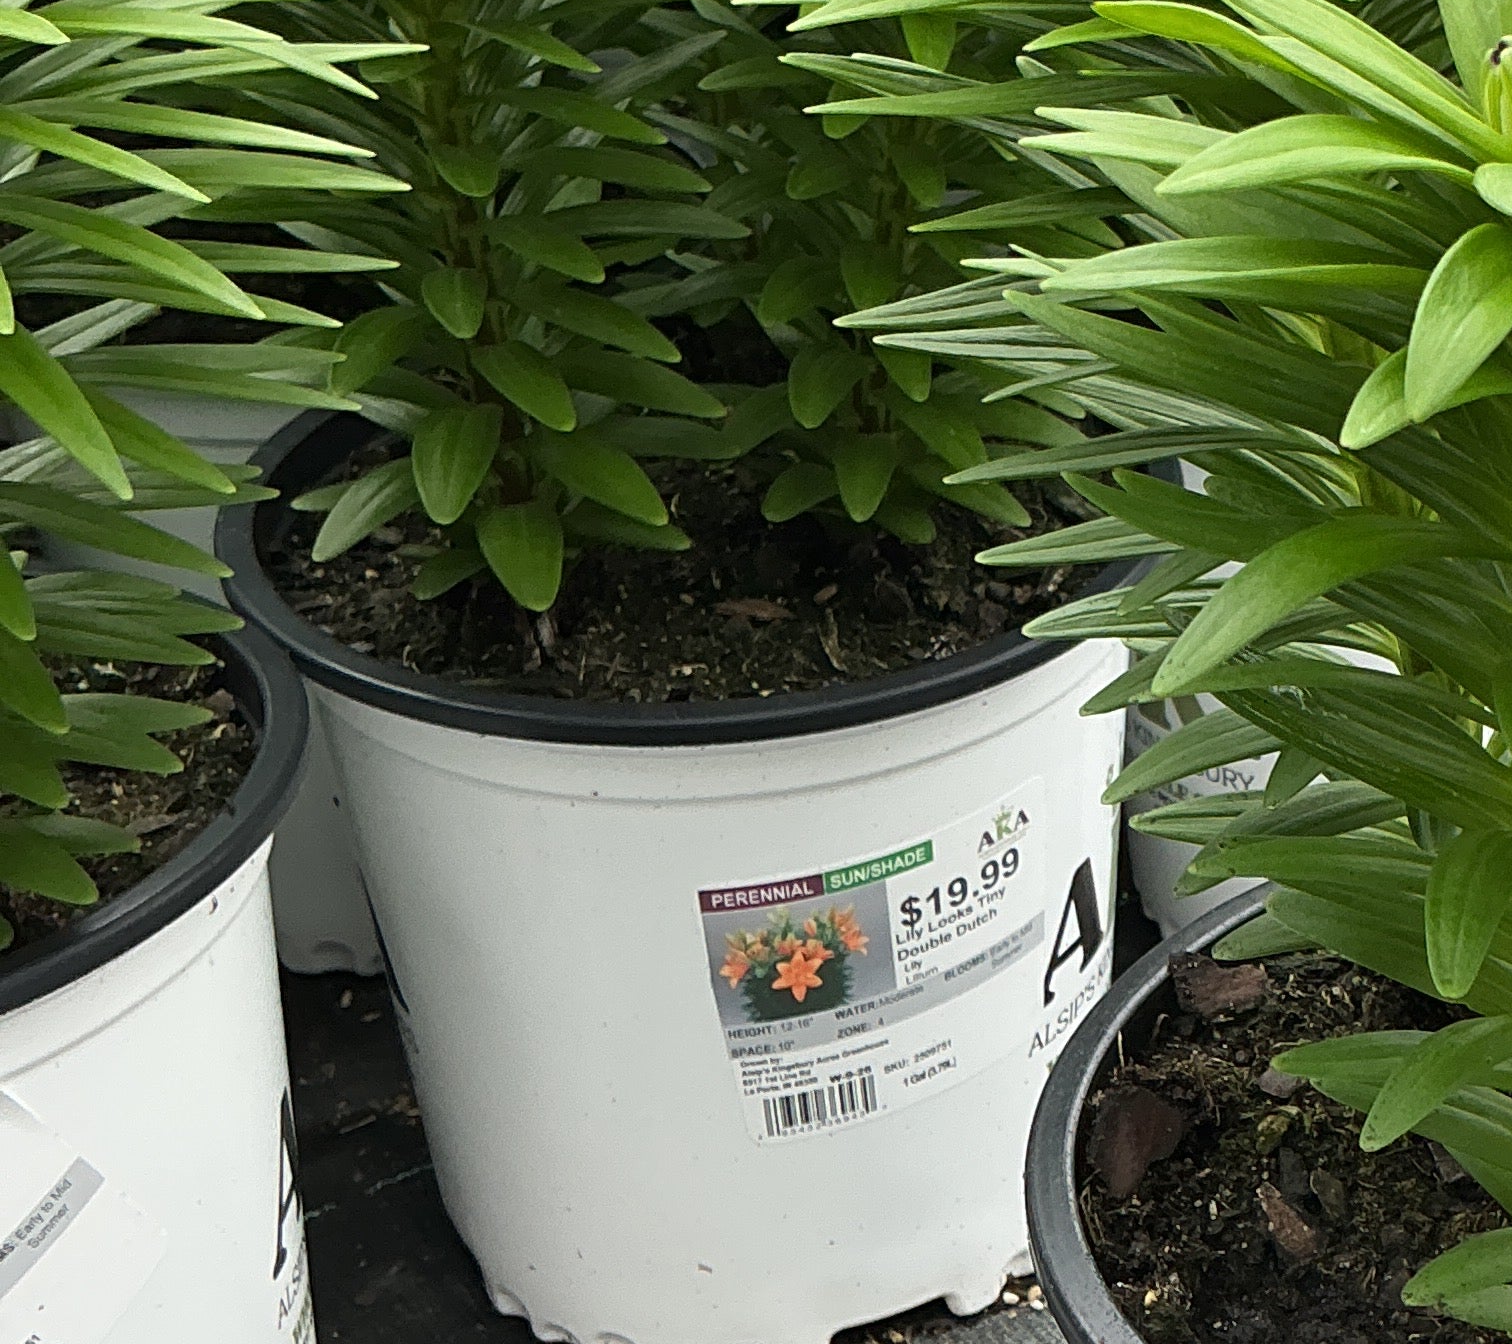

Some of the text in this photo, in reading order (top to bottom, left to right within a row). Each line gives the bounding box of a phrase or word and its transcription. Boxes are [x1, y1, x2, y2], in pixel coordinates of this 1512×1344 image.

[830, 848, 926, 889] SUN/SHADE
[900, 848, 1019, 928] $19.99
[711, 881, 814, 908] PERENNIAL
[895, 886, 1006, 946] Lily Looks Tiny
[897, 908, 998, 962] Double Dutch
[1043, 857, 1103, 1007] A
[728, 1025, 777, 1040] HEIGHT:
[731, 1042, 776, 1057] SPACE:
